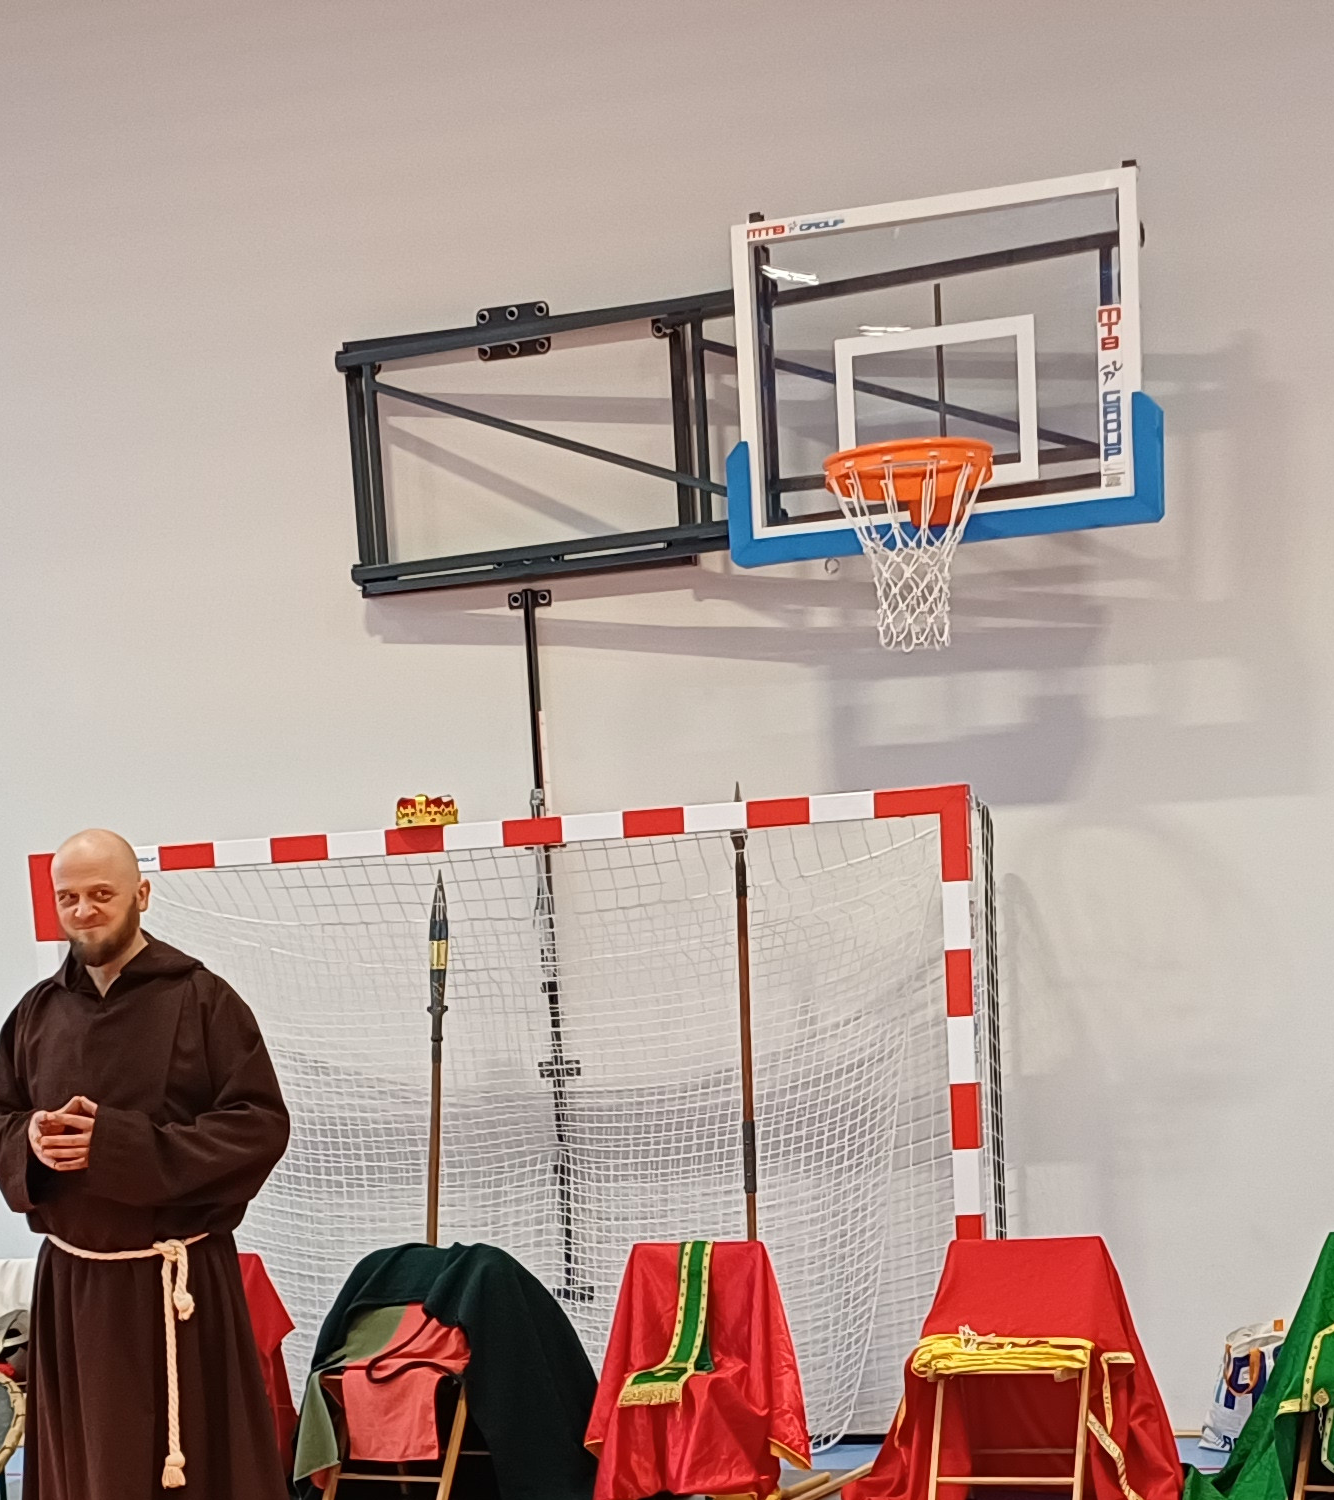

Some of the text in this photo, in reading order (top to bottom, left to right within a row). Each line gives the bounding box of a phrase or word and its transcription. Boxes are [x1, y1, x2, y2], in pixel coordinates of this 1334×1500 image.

[747, 225, 785, 240] MTB
[1098, 306, 1121, 351] MTB
[1102, 389, 1122, 462] GROUP
